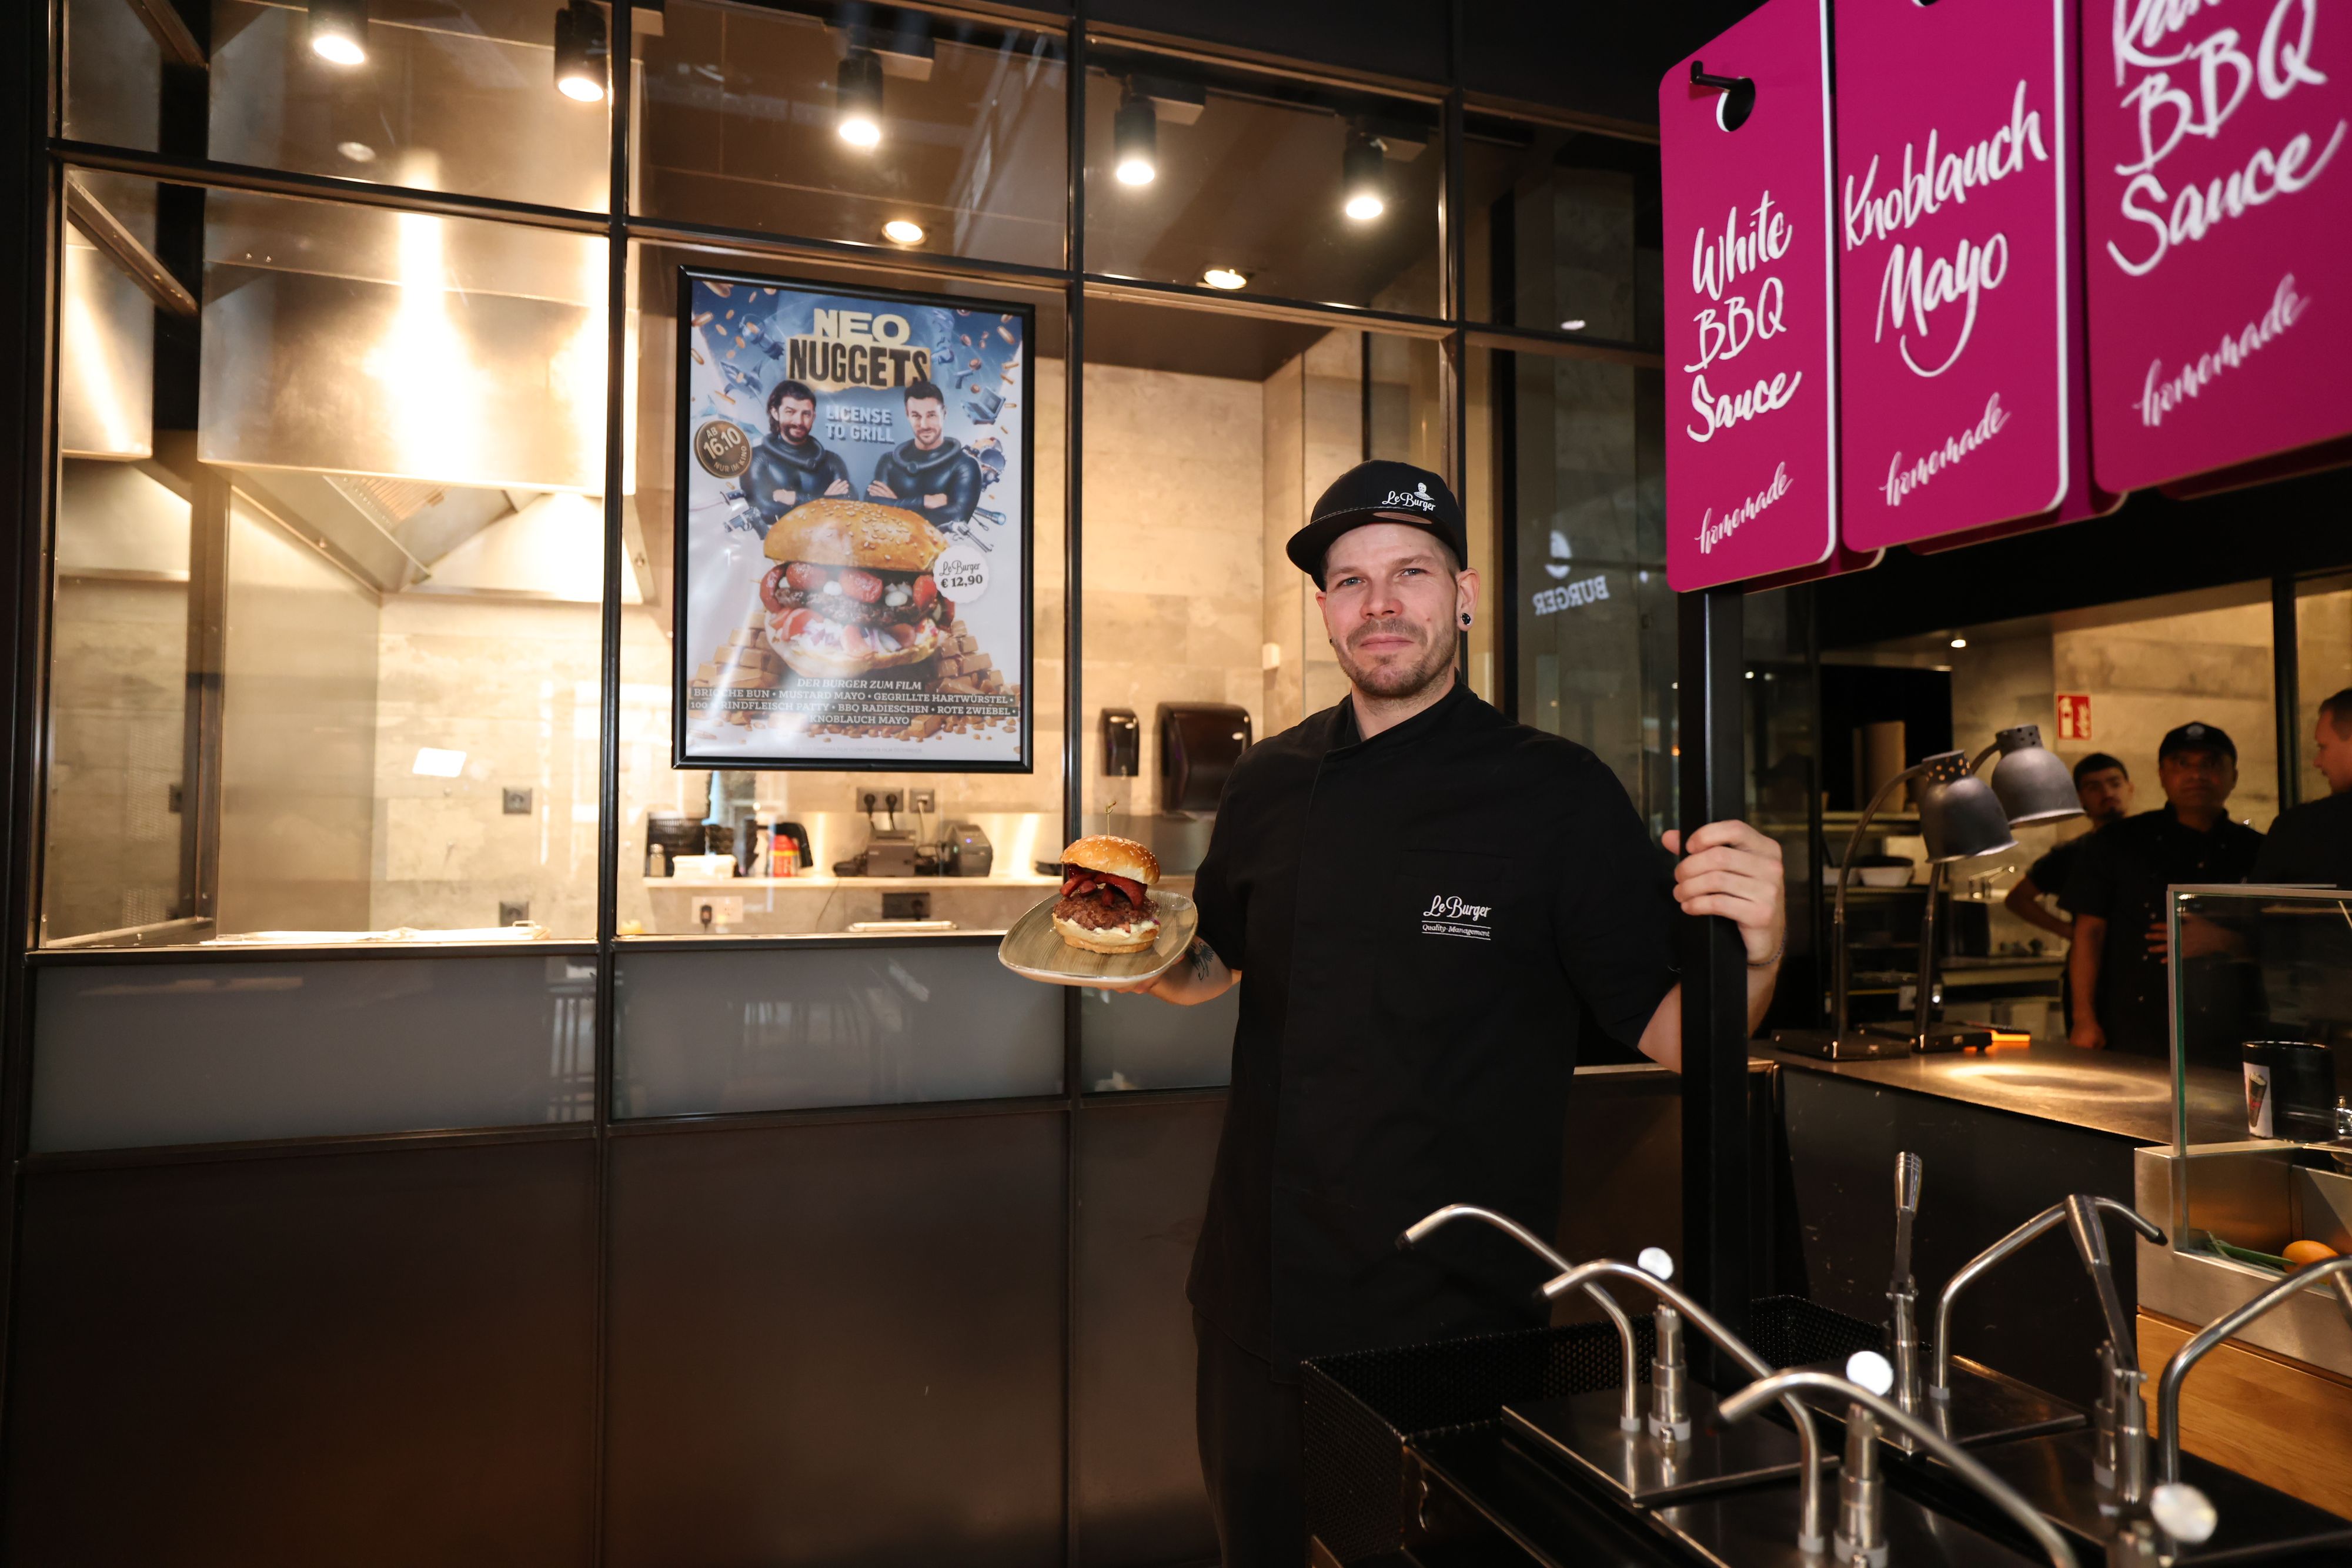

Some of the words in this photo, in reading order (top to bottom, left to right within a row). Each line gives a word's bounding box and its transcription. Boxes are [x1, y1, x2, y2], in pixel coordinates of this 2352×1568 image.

[2114, 0, 2328, 175] BBQ
[1843, 79, 2049, 252] Knoblauch
[2106, 119, 2348, 276] Sauce
[1692, 190, 1793, 301] White
[1875, 233, 2009, 377] Mayo
[814, 308, 911, 345] NEO
[1683, 277, 1788, 373] BBQ
[789, 338, 928, 387] NUGGETS
[2132, 272, 2313, 426] homemade
[826, 405, 893, 425] LICENSE
[1686, 371, 1802, 443] Sauce
[703, 427, 741, 459] 16.10
[706, 427, 717, 439] AB
[826, 423, 846, 439] TO
[850, 425, 894, 443] GRILL
[1879, 392, 2012, 506] homemade
[714, 462, 730, 473] NUR
[730, 463, 740, 472] IM
[739, 446, 747, 466] KINO
[1382, 490, 1400, 505] Le
[1400, 492, 1436, 511] Burger
[1694, 461, 1794, 554] homemade
[939, 560, 952, 576] Le
[951, 560, 981, 574] Burger
[941, 579, 948, 588] €
[951, 574, 983, 588] 12,90
[746, 689, 770, 698] BUN
[779, 690, 832, 700] MUSTARD
[834, 691, 866, 700] MAYO
[874, 693, 930, 702] GEGRILLTE
[932, 693, 1008, 704] HARTWÜRSTEL
[797, 678, 820, 687] DER
[821, 679, 867, 688] BURGER
[869, 680, 893, 689] ZUM
[896, 681, 922, 690] FILM
[720, 701, 793, 711] RINDFLEISCH
[796, 703, 830, 711] PATTY
[837, 704, 860, 713] BBQ
[862, 704, 929, 714] RADIESCHEN
[937, 706, 964, 715] ROTE
[965, 706, 1011, 716] ZWIEBEL
[810, 715, 877, 724] KNOBLAUCH
[878, 716, 910, 725] MAYO
[1423, 895, 1446, 917] Le
[1446, 895, 1492, 921] Burger
